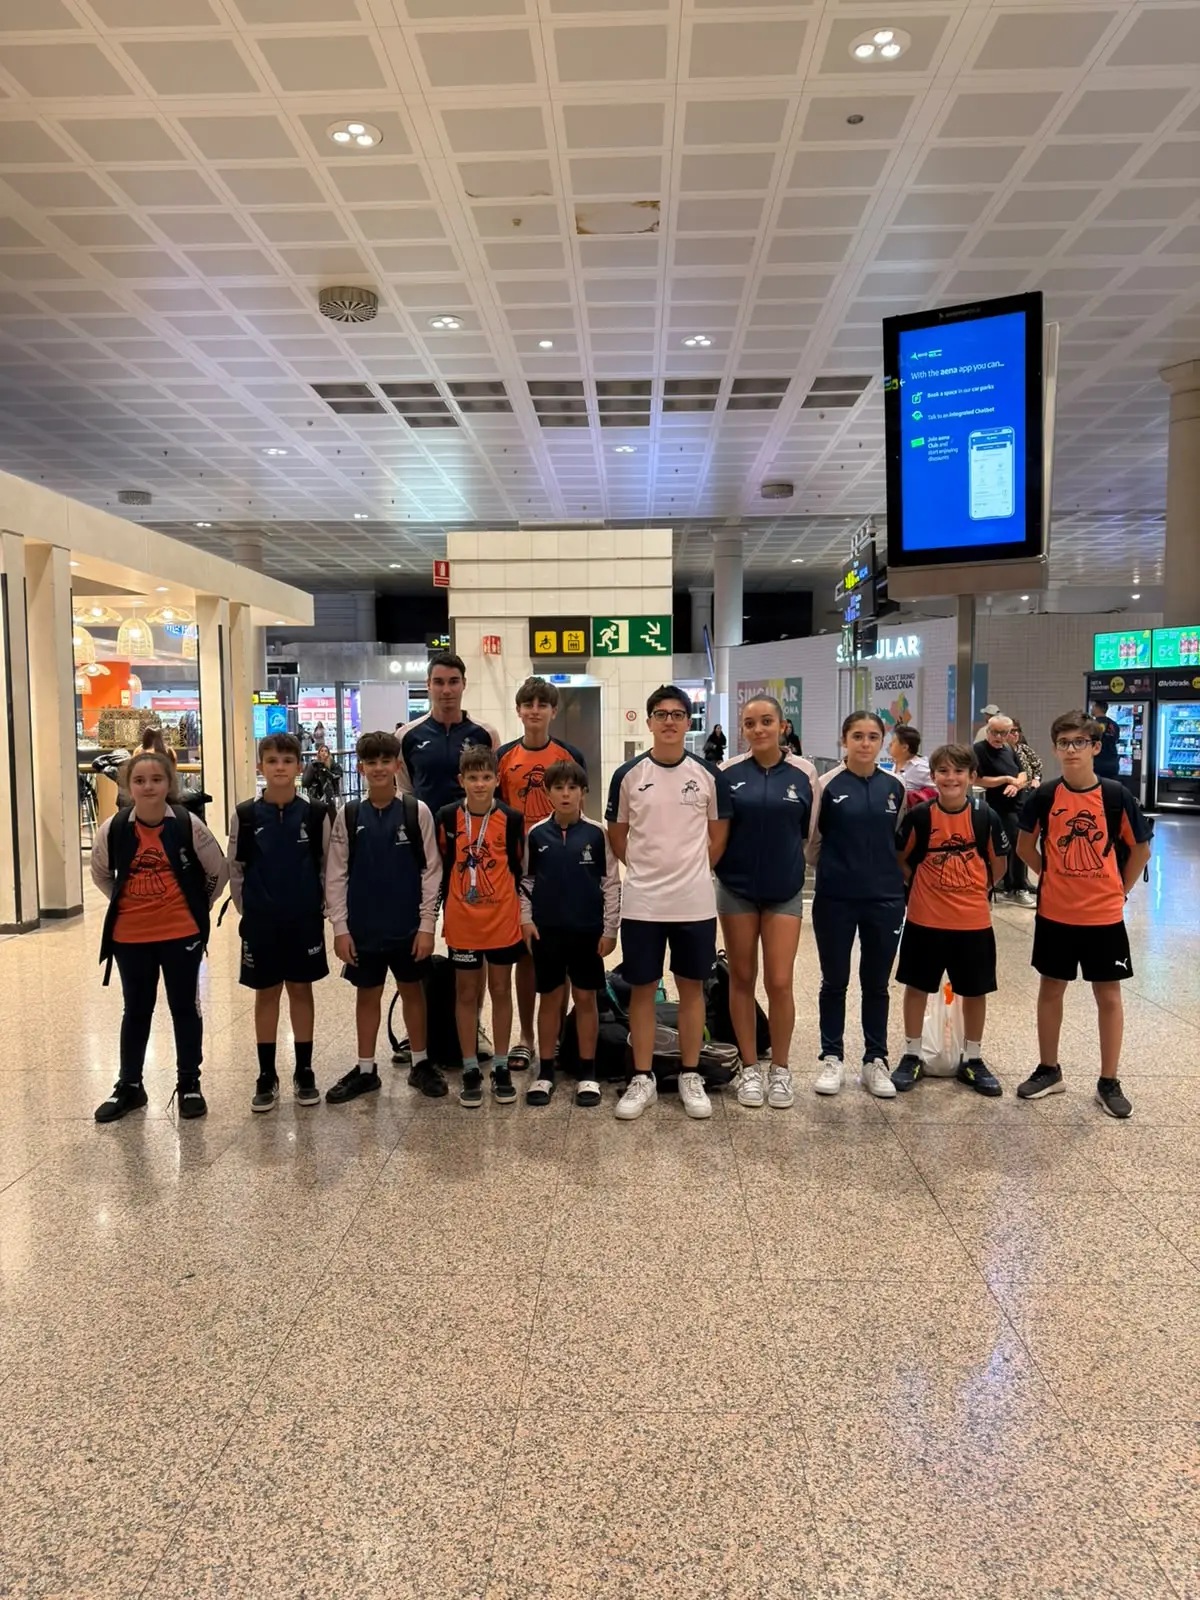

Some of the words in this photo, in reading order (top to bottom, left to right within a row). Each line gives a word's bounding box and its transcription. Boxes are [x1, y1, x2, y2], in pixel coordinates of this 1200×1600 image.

[911, 371, 927, 380] With
[928, 369, 939, 378] the
[940, 367, 958, 376] aena
[959, 365, 973, 374] app
[973, 362, 987, 373] you
[944, 389, 957, 397] space
[980, 384, 994, 392] parks
[836, 635, 920, 663] SULAR
[875, 680, 913, 691] BARCELONA
